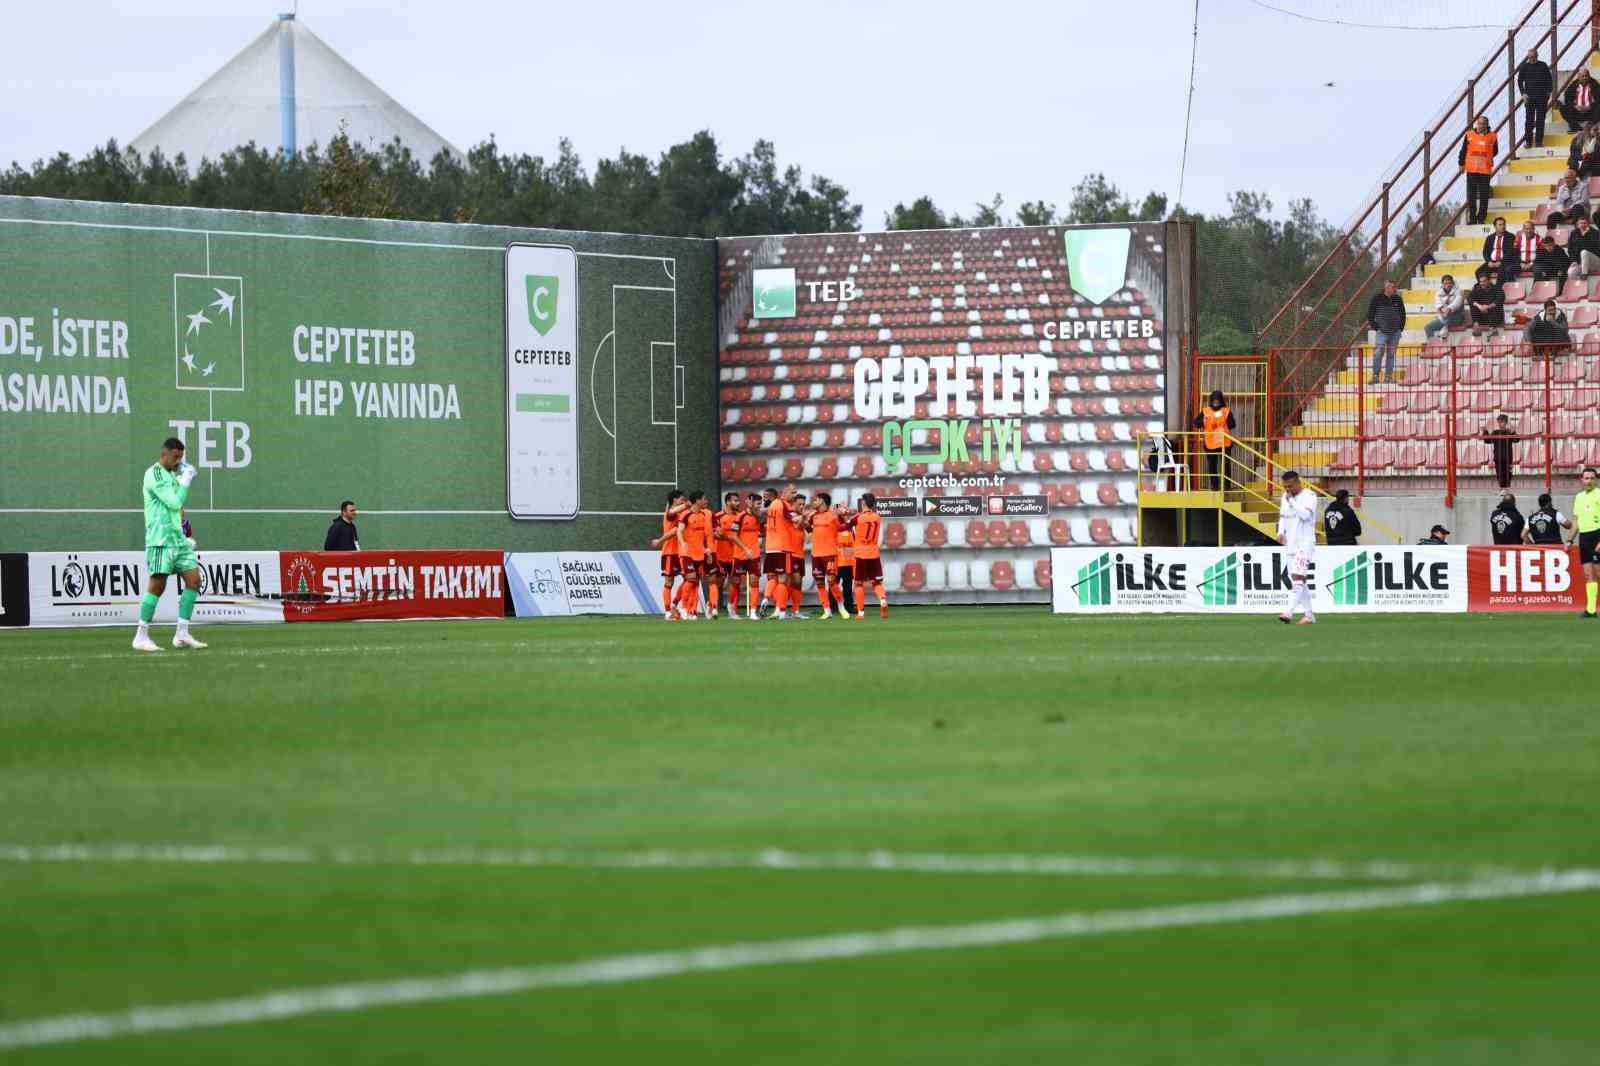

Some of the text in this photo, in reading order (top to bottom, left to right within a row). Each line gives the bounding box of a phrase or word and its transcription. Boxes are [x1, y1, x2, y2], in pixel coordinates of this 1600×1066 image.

[804, 280, 857, 303] TEB
[53, 307, 129, 358] İSTER
[1043, 319, 1154, 340] CEPTETEB
[293, 325, 416, 366] CEPTETEB
[514, 348, 572, 366] CEPTETEB
[853, 353, 1051, 420] CEPTETEB
[295, 379, 461, 419] HEP YANINDA
[168, 420, 252, 468] TEB
[899, 473, 1006, 490] cepteteb.com.tr
[940, 504, 979, 514] Google Play
[1006, 504, 1043, 512] AppGallery
[51, 554, 140, 599] LÖWEN
[562, 560, 604, 572] SAĞLIKLI
[1489, 550, 1571, 592] HEB
[322, 558, 415, 604] SEMTİN
[420, 565, 502, 599] TAKIMI
[566, 572, 622, 588] GÜLÜŞLERİN
[569, 586, 602, 599] ADRESİ
